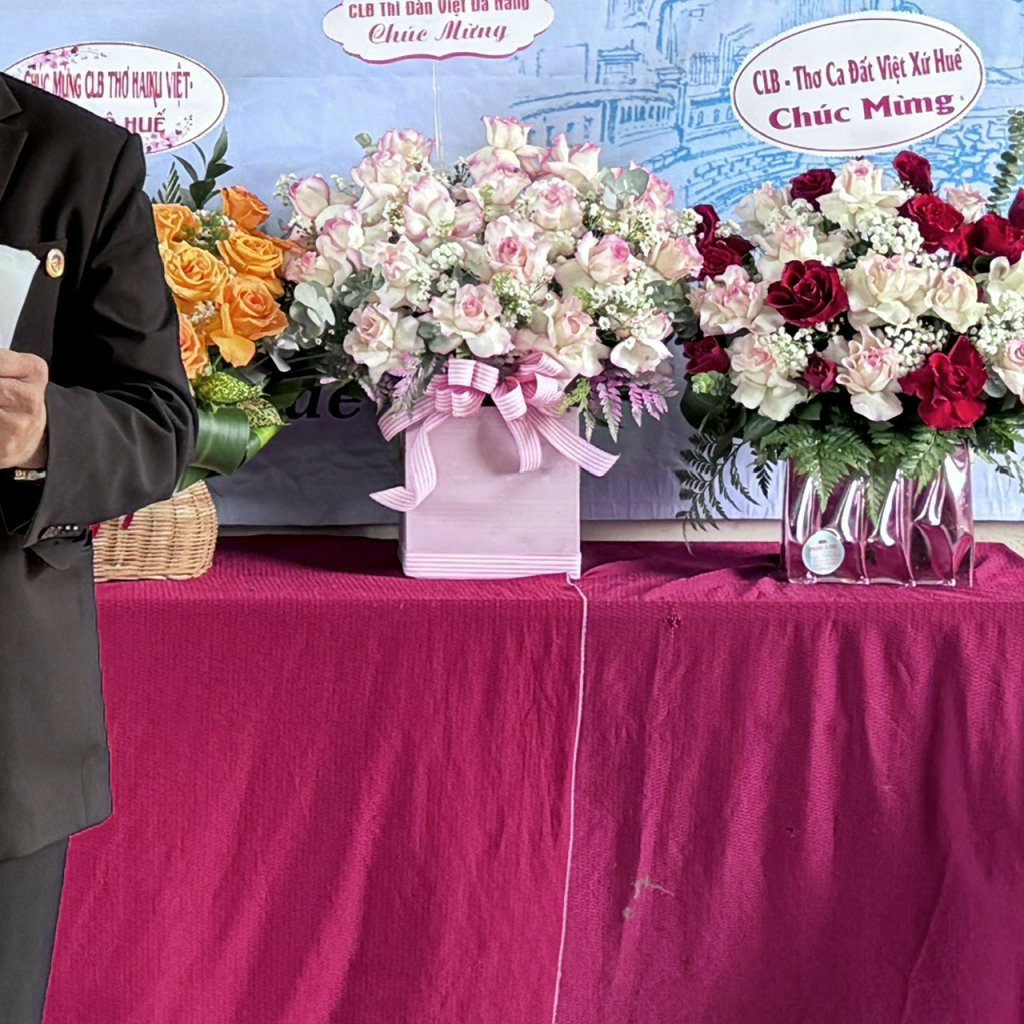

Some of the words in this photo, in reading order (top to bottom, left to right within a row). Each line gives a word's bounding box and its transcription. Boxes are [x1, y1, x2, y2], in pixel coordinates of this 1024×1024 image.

[349, 2, 375, 19] CLB
[368, 23, 429, 44] Chúc
[434, 20, 508, 43] Mừng
[752, 69, 781, 95] CLB
[793, 65, 822, 91] Thơ
[826, 61, 845, 87] Ca
[848, 56, 875, 84] Đất
[877, 54, 908, 85] Việt
[909, 49, 932, 77] Xứ
[933, 44, 963, 73] Huế
[84, 70, 104, 98] CLB
[124, 108, 167, 133] HUẾ
[768, 104, 851, 131] Chúc
[861, 93, 955, 121] Mừng
